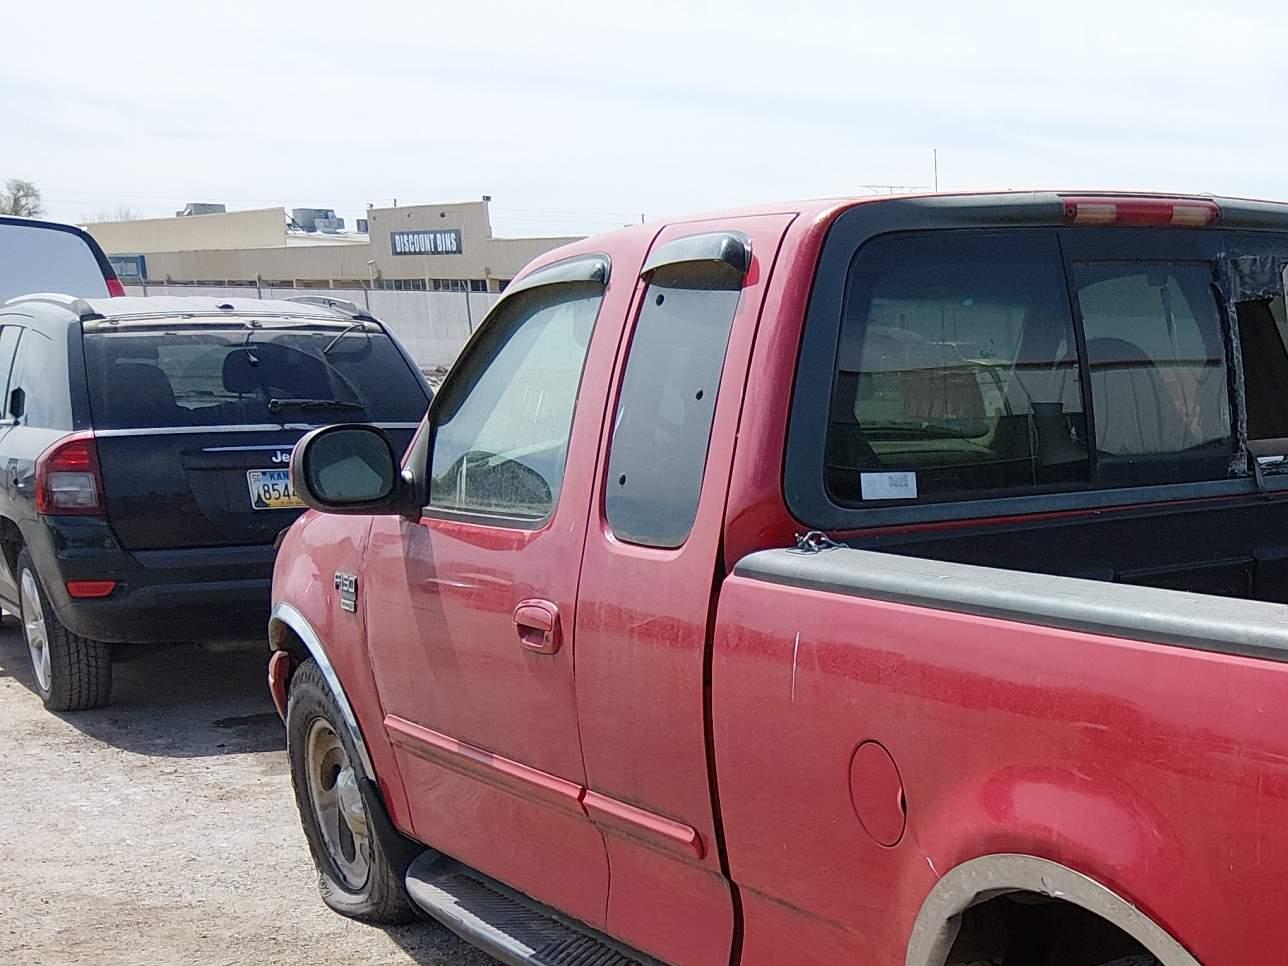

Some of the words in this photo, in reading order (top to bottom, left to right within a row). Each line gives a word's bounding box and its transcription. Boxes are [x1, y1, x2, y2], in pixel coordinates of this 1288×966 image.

[395, 233, 435, 253] DISCOUNT
[436, 232, 457, 252] BINS
[271, 450, 291, 463] Je
[270, 471, 290, 481] KAN
[262, 482, 298, 501] 854
